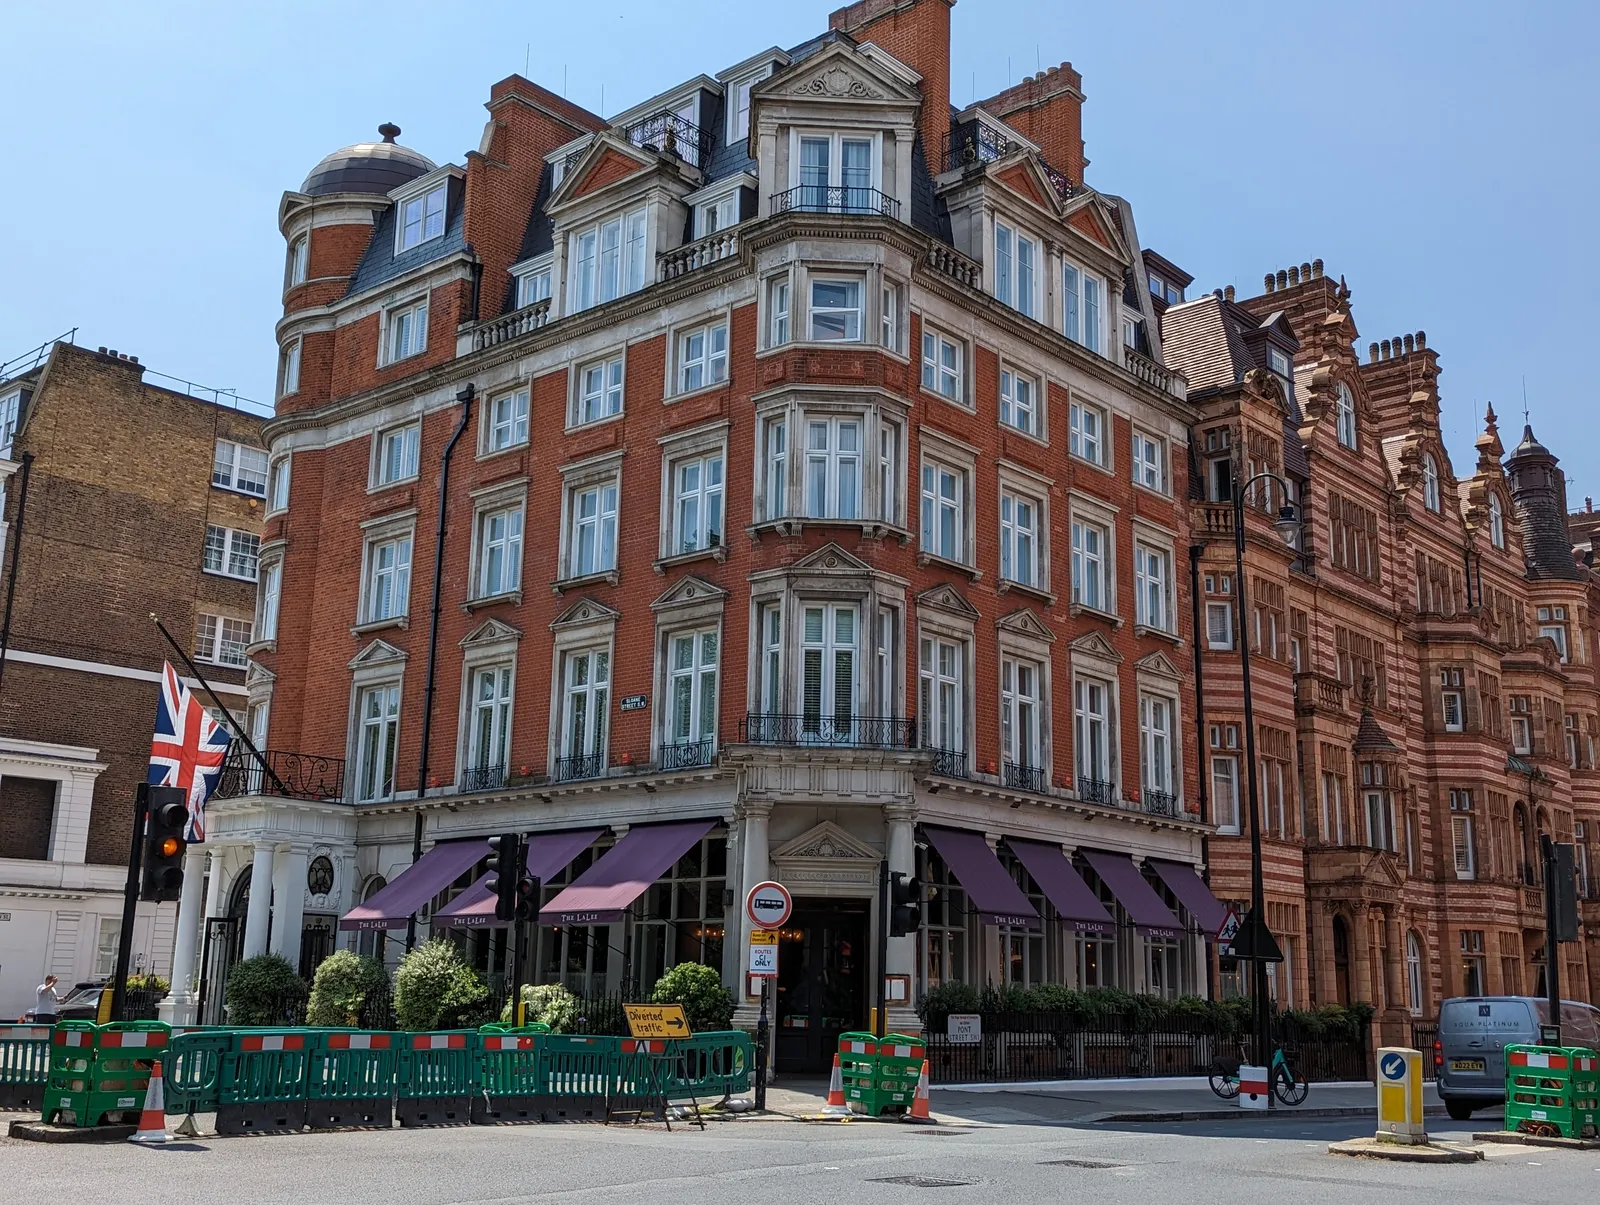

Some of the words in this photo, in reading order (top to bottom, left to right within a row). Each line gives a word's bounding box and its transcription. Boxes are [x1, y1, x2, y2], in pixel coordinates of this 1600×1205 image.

[621, 701, 637, 709] STREET
[629, 1011, 663, 1020] Diverted
[636, 1023, 663, 1032] traffic
